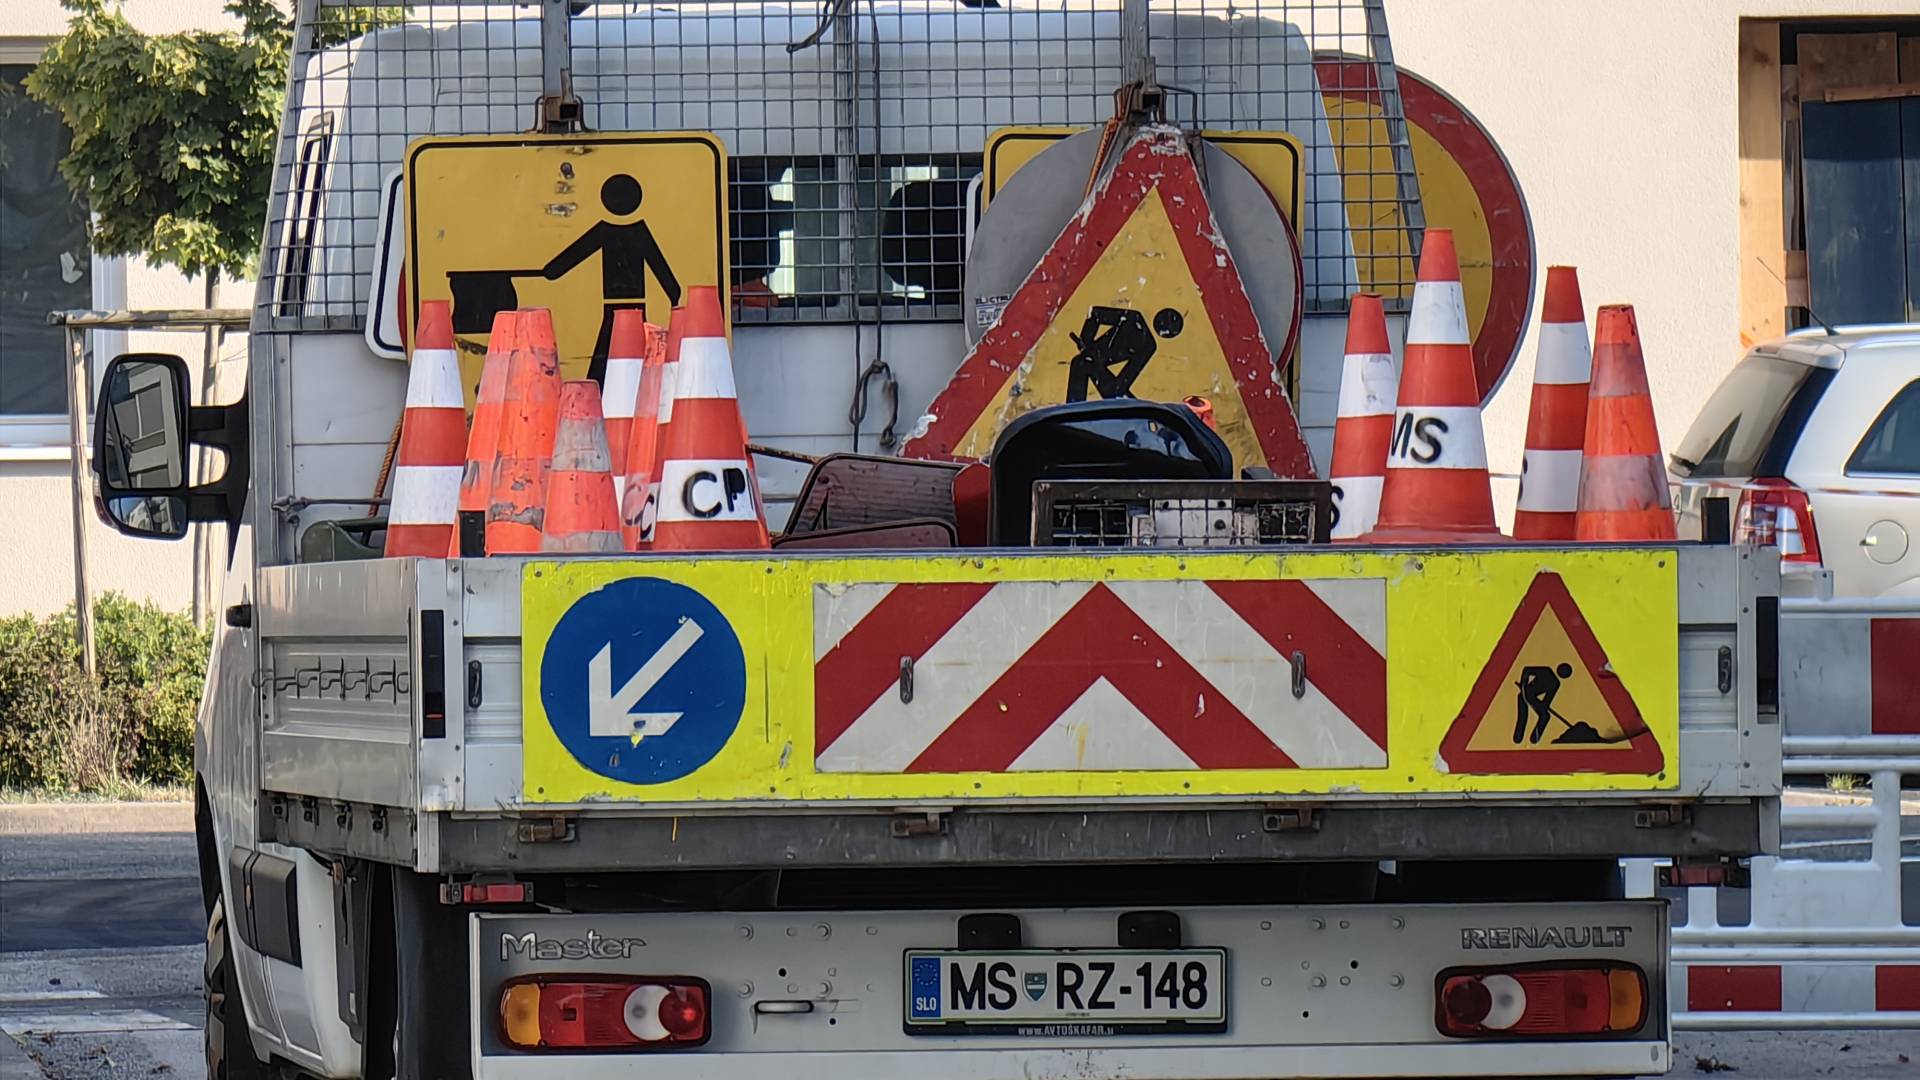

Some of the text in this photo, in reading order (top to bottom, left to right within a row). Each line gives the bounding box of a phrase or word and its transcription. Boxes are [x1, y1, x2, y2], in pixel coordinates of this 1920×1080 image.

[501, 929, 647, 961] Master
[1461, 926, 1633, 949] RENAULT
[950, 961, 1208, 1011] MS RZ-148
[915, 997, 937, 1011] SLO
